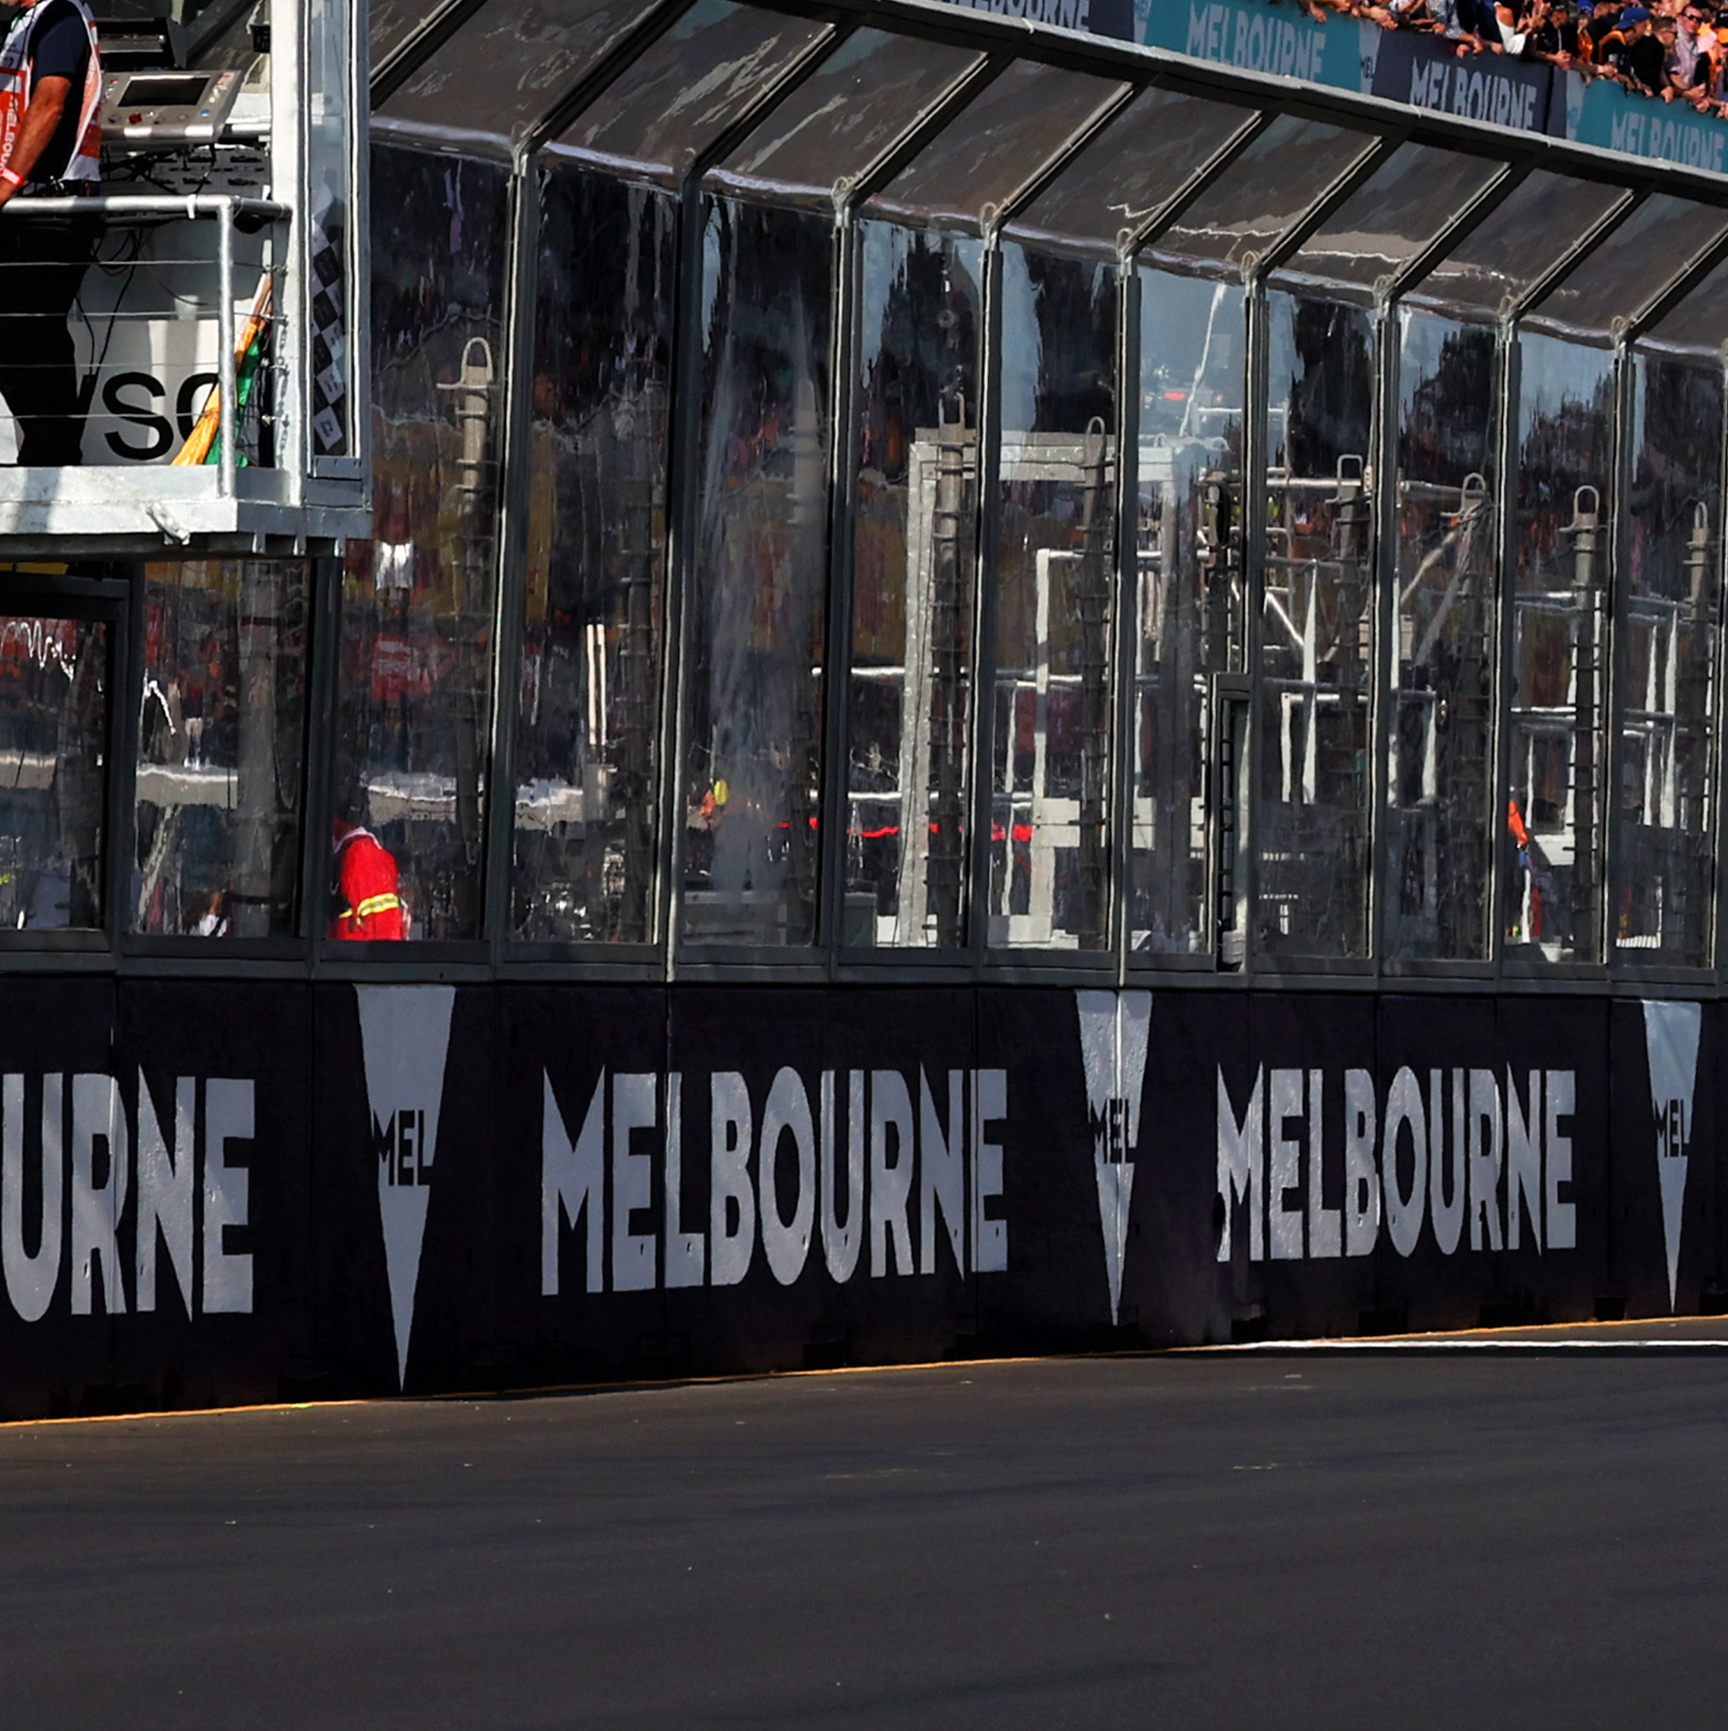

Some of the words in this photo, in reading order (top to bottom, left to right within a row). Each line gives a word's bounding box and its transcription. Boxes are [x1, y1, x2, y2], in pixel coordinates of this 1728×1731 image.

[1186, 0, 1327, 83] MELBOURNE
[373, 1108, 432, 1189] MEL
[1091, 1097, 1137, 1165] MEL
[1216, 1061, 1577, 1263] MELBOURNE
[1653, 1096, 1692, 1159] MEL
[2, 1065, 256, 1322] URNE
[541, 1063, 1008, 1296] MELBOURNE
